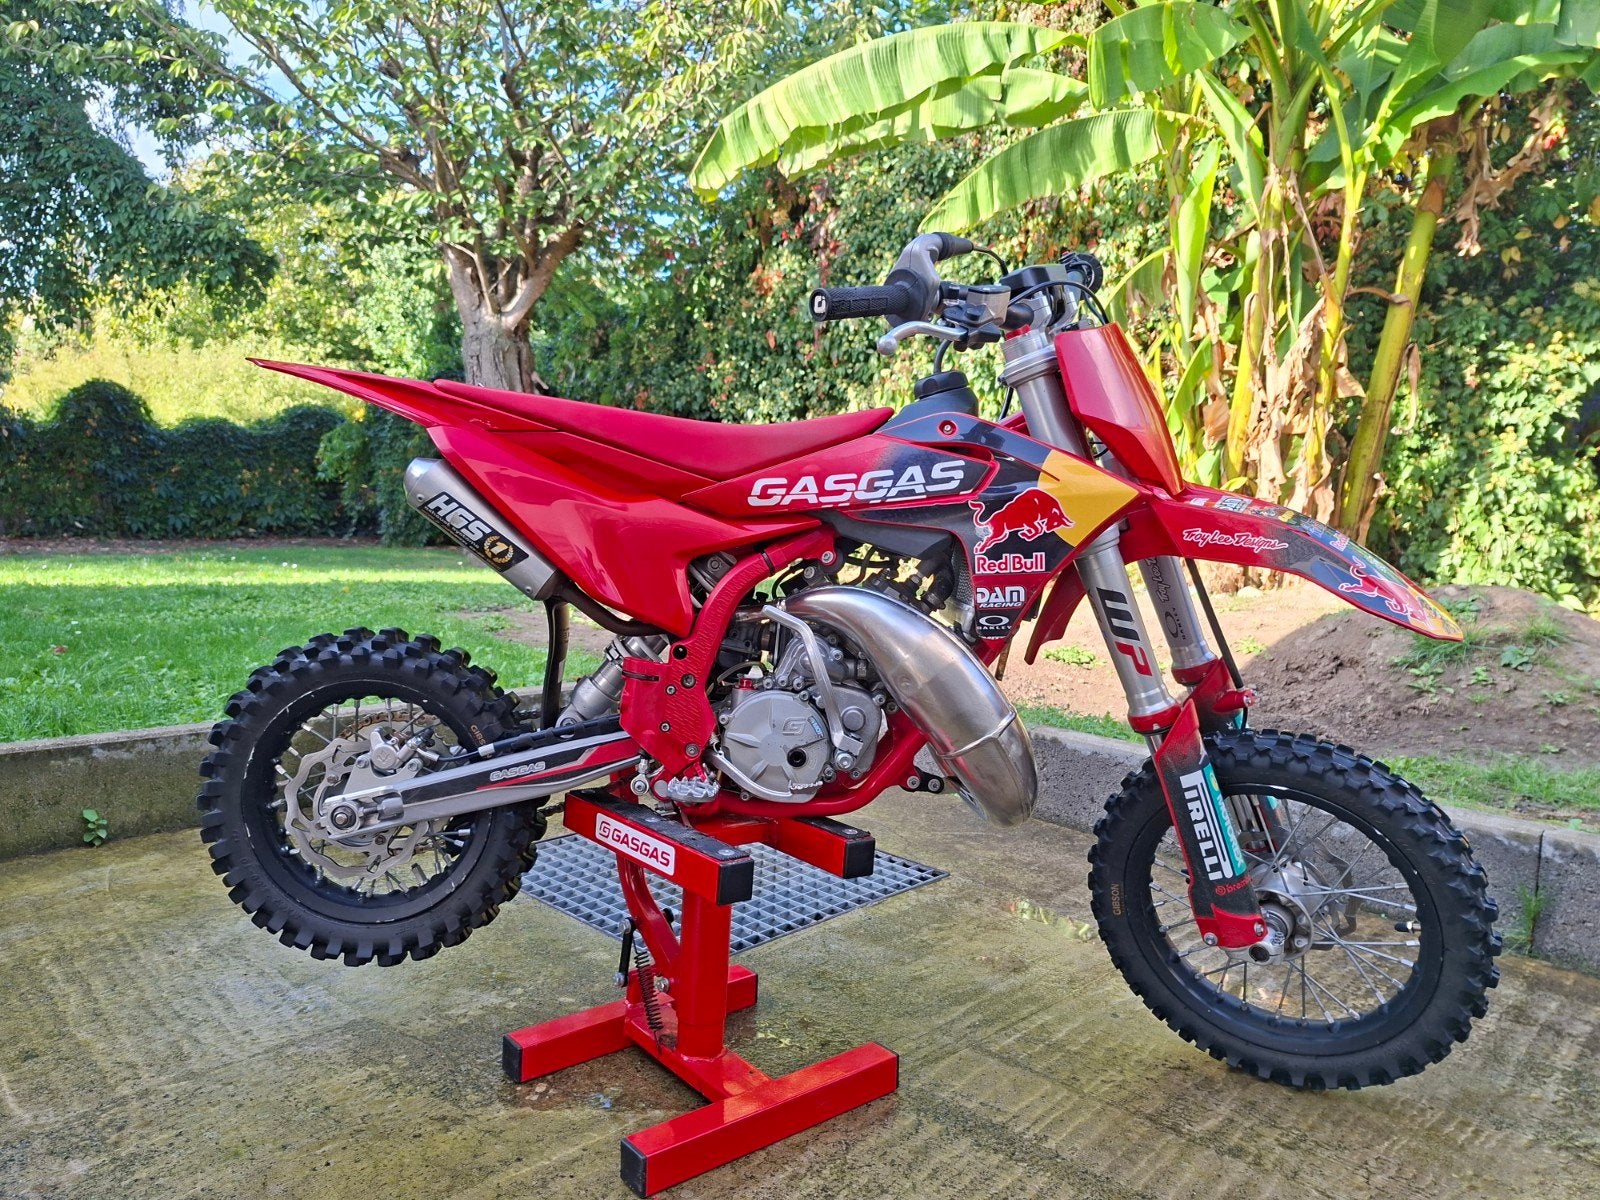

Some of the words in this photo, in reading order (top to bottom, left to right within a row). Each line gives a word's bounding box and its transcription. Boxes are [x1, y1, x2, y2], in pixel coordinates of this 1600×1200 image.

[748, 460, 965, 507] GASGAS
[427, 495, 492, 542] HGS
[1183, 528, 1211, 547] Troy
[1209, 530, 1234, 544] Lee
[1233, 533, 1288, 553] Designs
[975, 554, 1010, 574] Red
[1010, 552, 1045, 573] Bull
[976, 586, 1025, 603] DAM
[1096, 587, 1152, 676] WP
[490, 761, 546, 781] GASGAS
[1179, 770, 1234, 881] PIRELLI
[1216, 792, 1244, 868] MOTOREX
[612, 828, 671, 867] GASGAS
[1111, 884, 1122, 915] GIBSON
